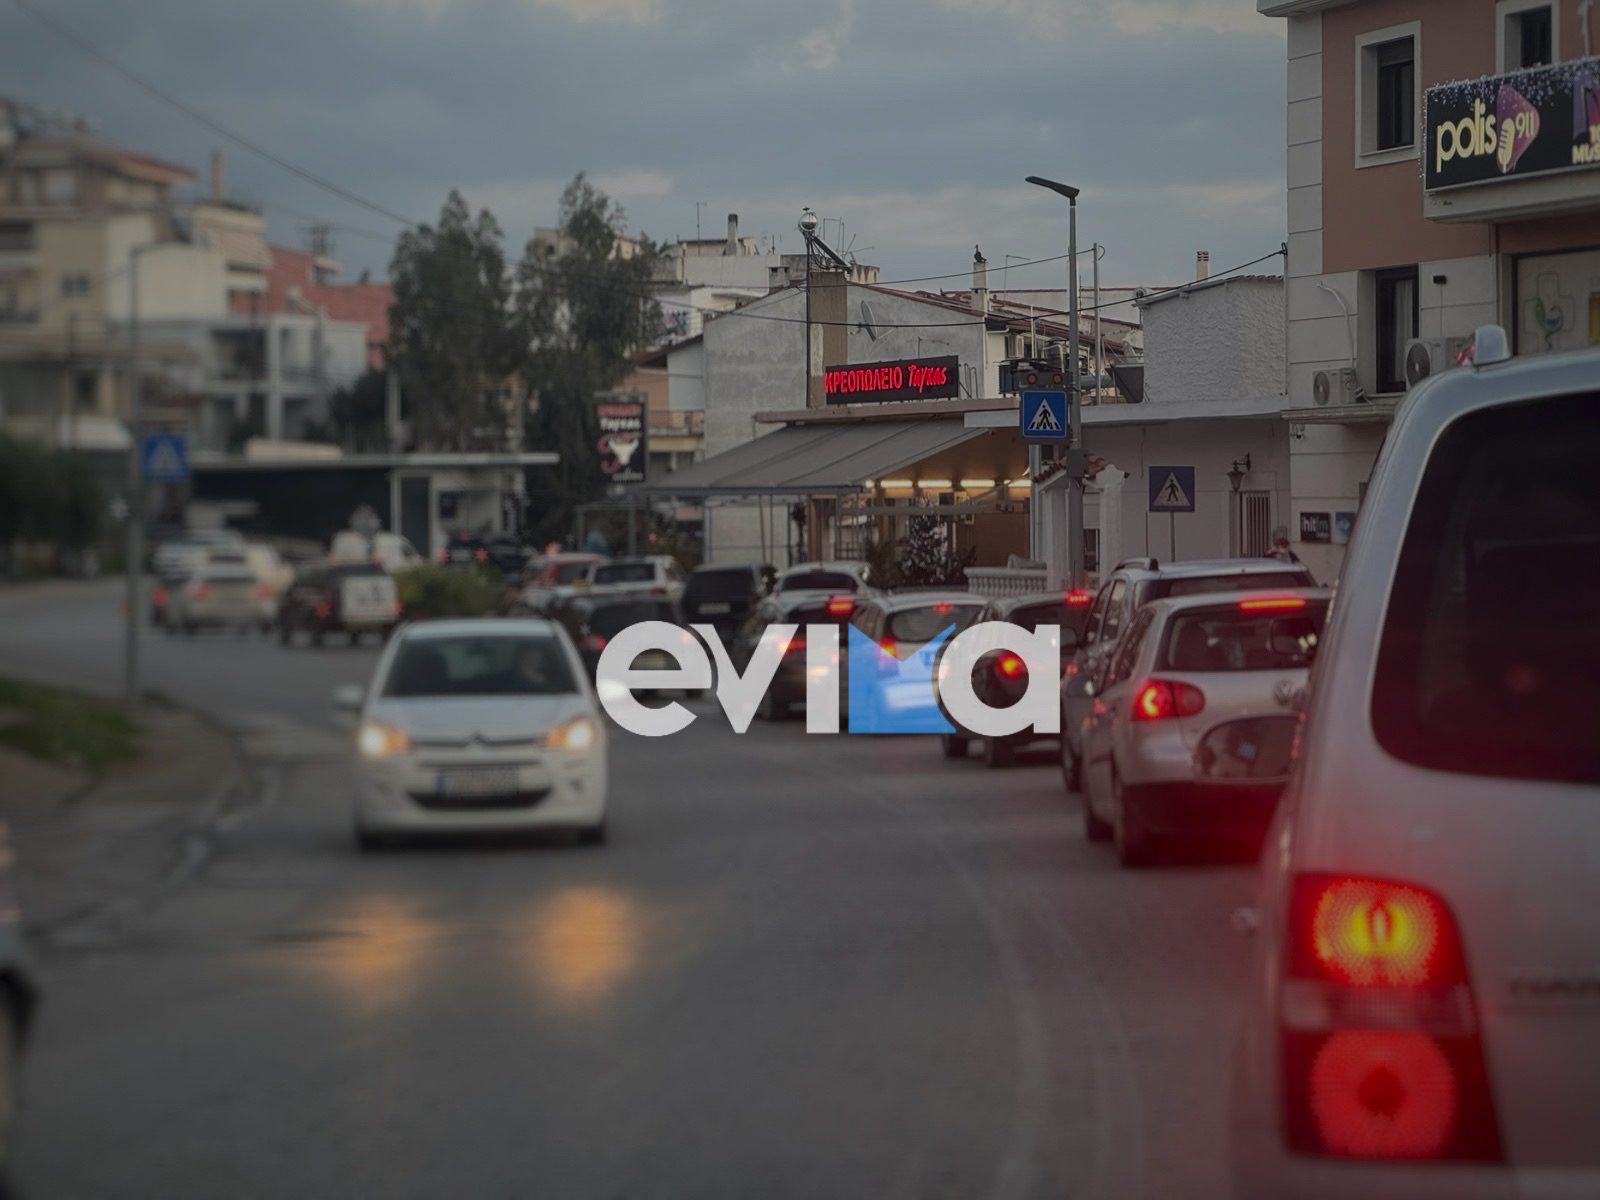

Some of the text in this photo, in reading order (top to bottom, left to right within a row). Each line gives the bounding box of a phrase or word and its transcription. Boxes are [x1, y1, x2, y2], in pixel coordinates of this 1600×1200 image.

[1436, 98, 1535, 173] polis 911
[824, 366, 903, 394] ΚΡΕΟΠΩΛΕΙΟ
